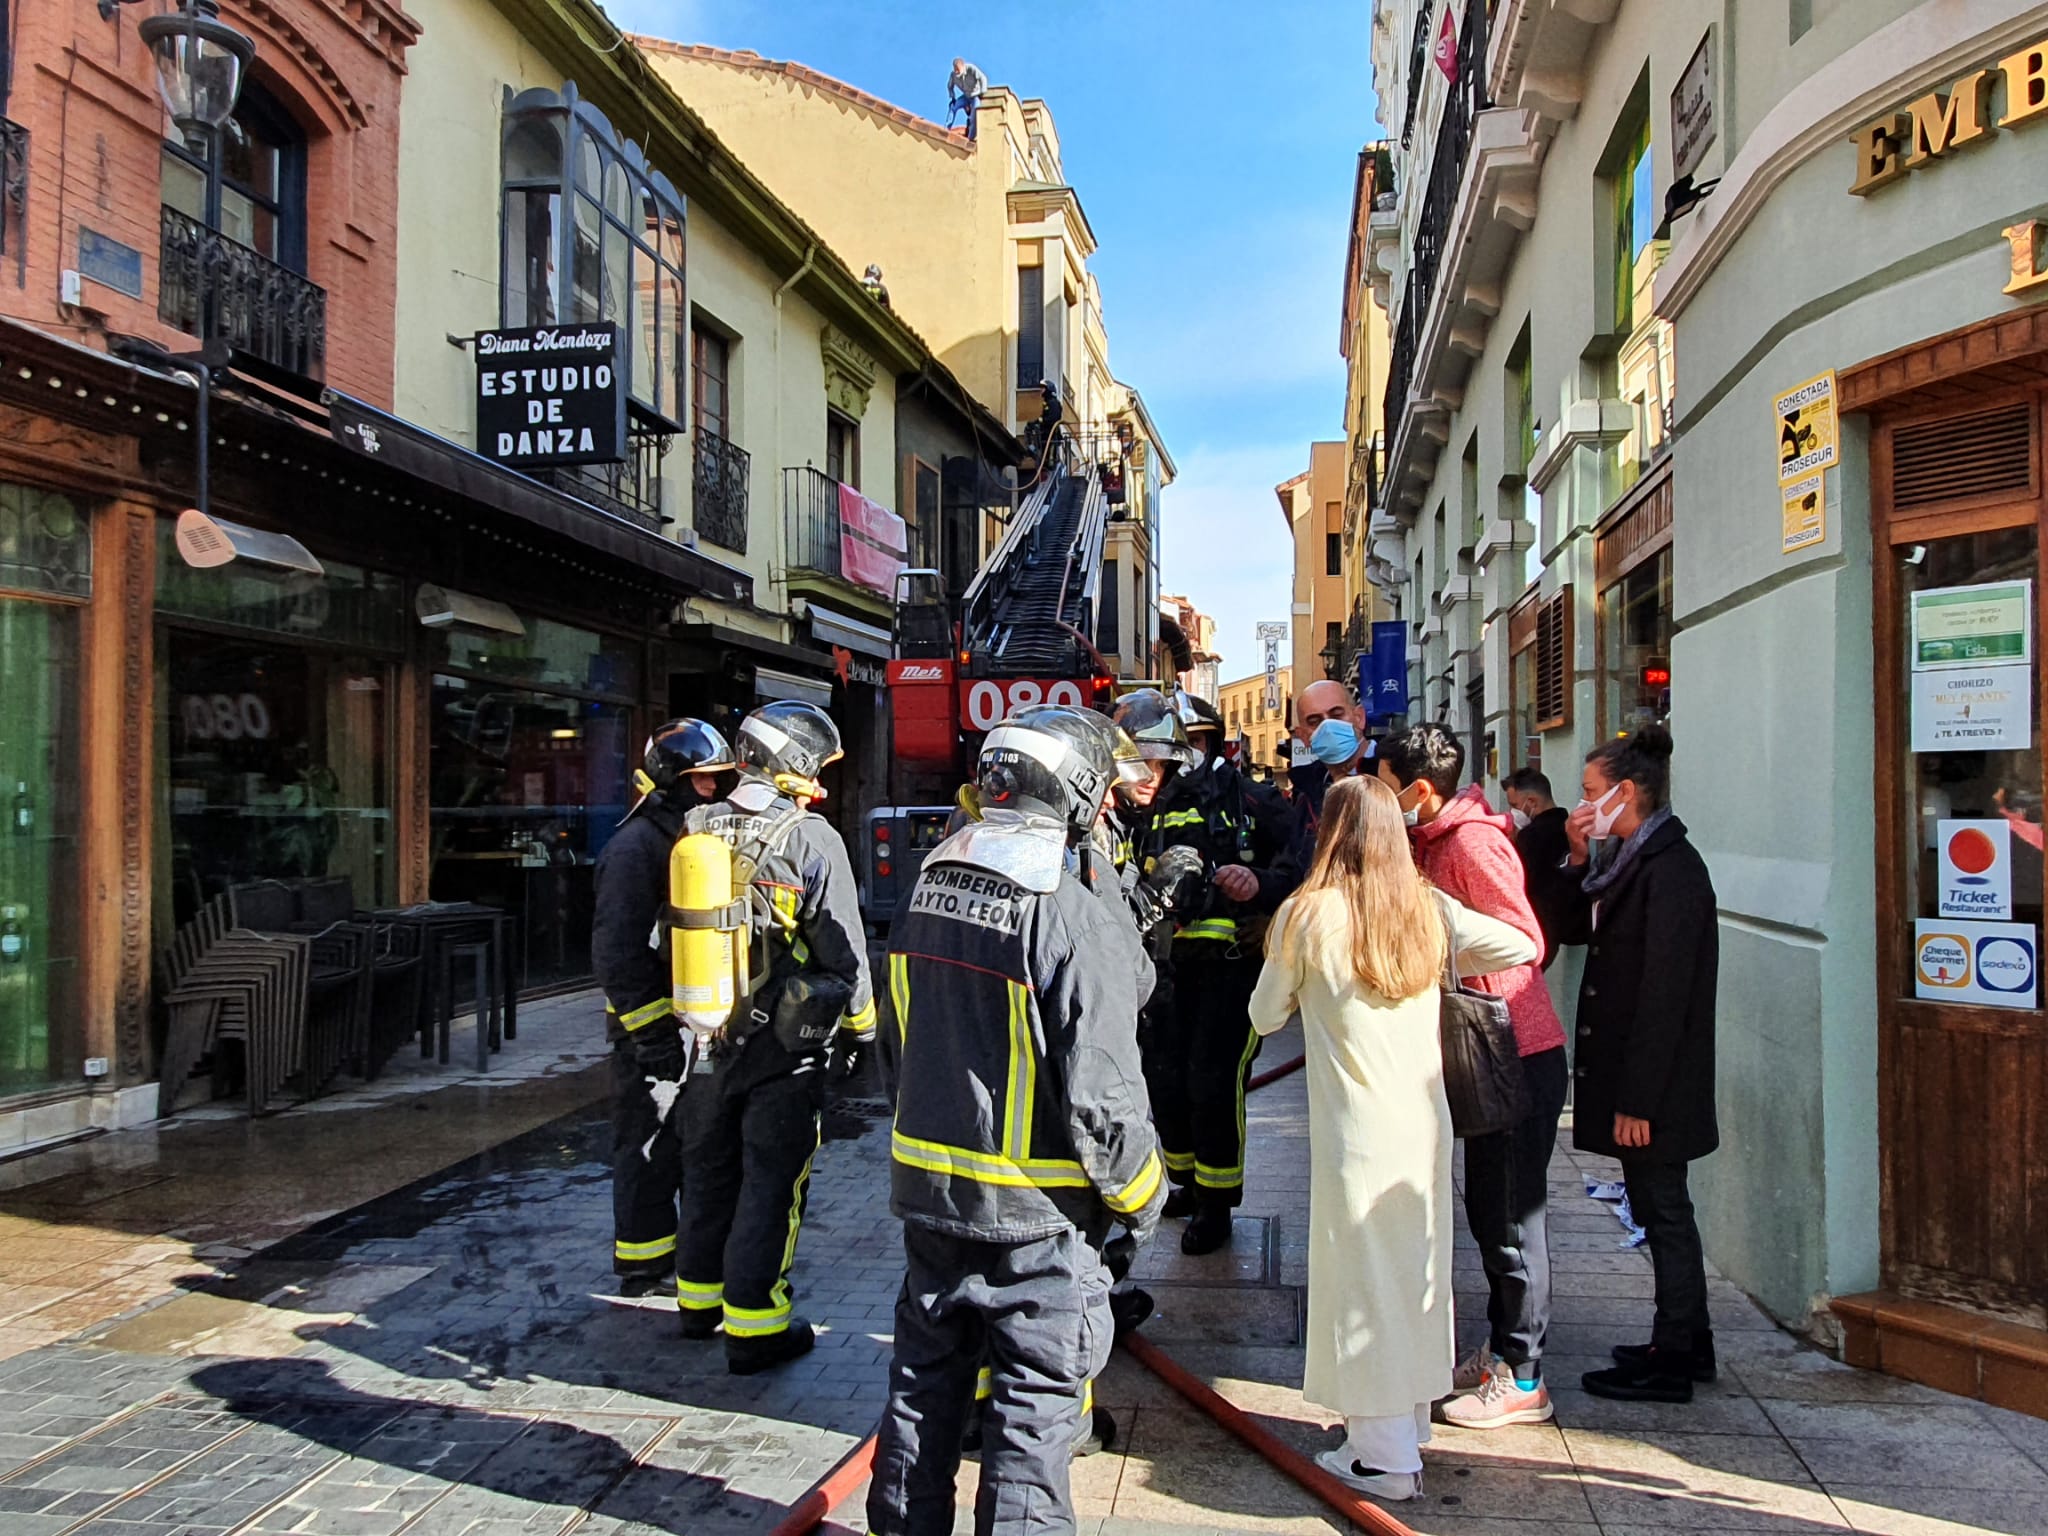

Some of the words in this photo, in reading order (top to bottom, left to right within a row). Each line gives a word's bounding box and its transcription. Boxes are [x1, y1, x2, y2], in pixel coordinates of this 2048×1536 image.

[1848, 40, 2048, 196] EMB
[479, 333, 530, 355] Diana
[533, 329, 611, 351] Mendoza
[481, 365, 611, 396] ESTUDIO
[1777, 379, 1829, 411] CONECTADA
[528, 399, 563, 424] DE
[498, 427, 594, 456] DANZA
[1781, 447, 1833, 477] PROSEGUR
[897, 666, 943, 680] Metz
[1266, 642, 1277, 709] MADRID
[1947, 679, 1994, 689] CHORIZO
[998, 752, 1019, 764] 2103
[923, 869, 1027, 904] BOMBEROS
[1949, 889, 1998, 903] Ticket
[912, 891, 962, 915] AYTO.
[966, 899, 1020, 930] LEÓN
[1921, 954, 1965, 965] Gourmet
[1925, 945, 1962, 957] Cheque
[1981, 957, 2026, 971] sodexo
